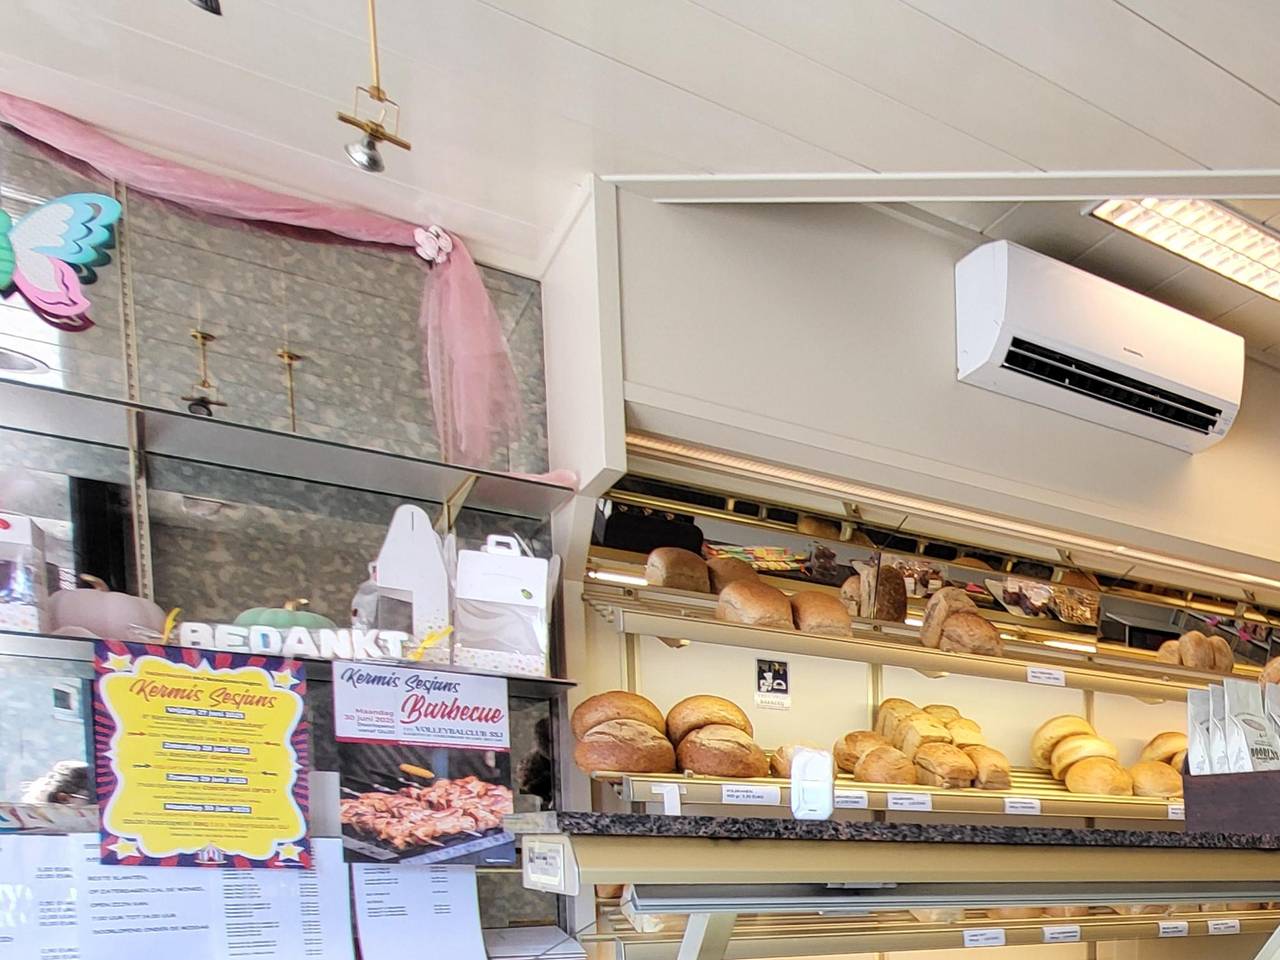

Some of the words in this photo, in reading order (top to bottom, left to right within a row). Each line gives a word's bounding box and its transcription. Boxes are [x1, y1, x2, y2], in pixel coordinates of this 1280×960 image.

[180, 622, 409, 659] BEDANKT
[129, 678, 204, 702] Kermis
[208, 687, 278, 709] Sesjans
[341, 667, 401, 688] Kermis
[405, 674, 461, 694] Sesjans
[400, 694, 504, 724] Barbecue
